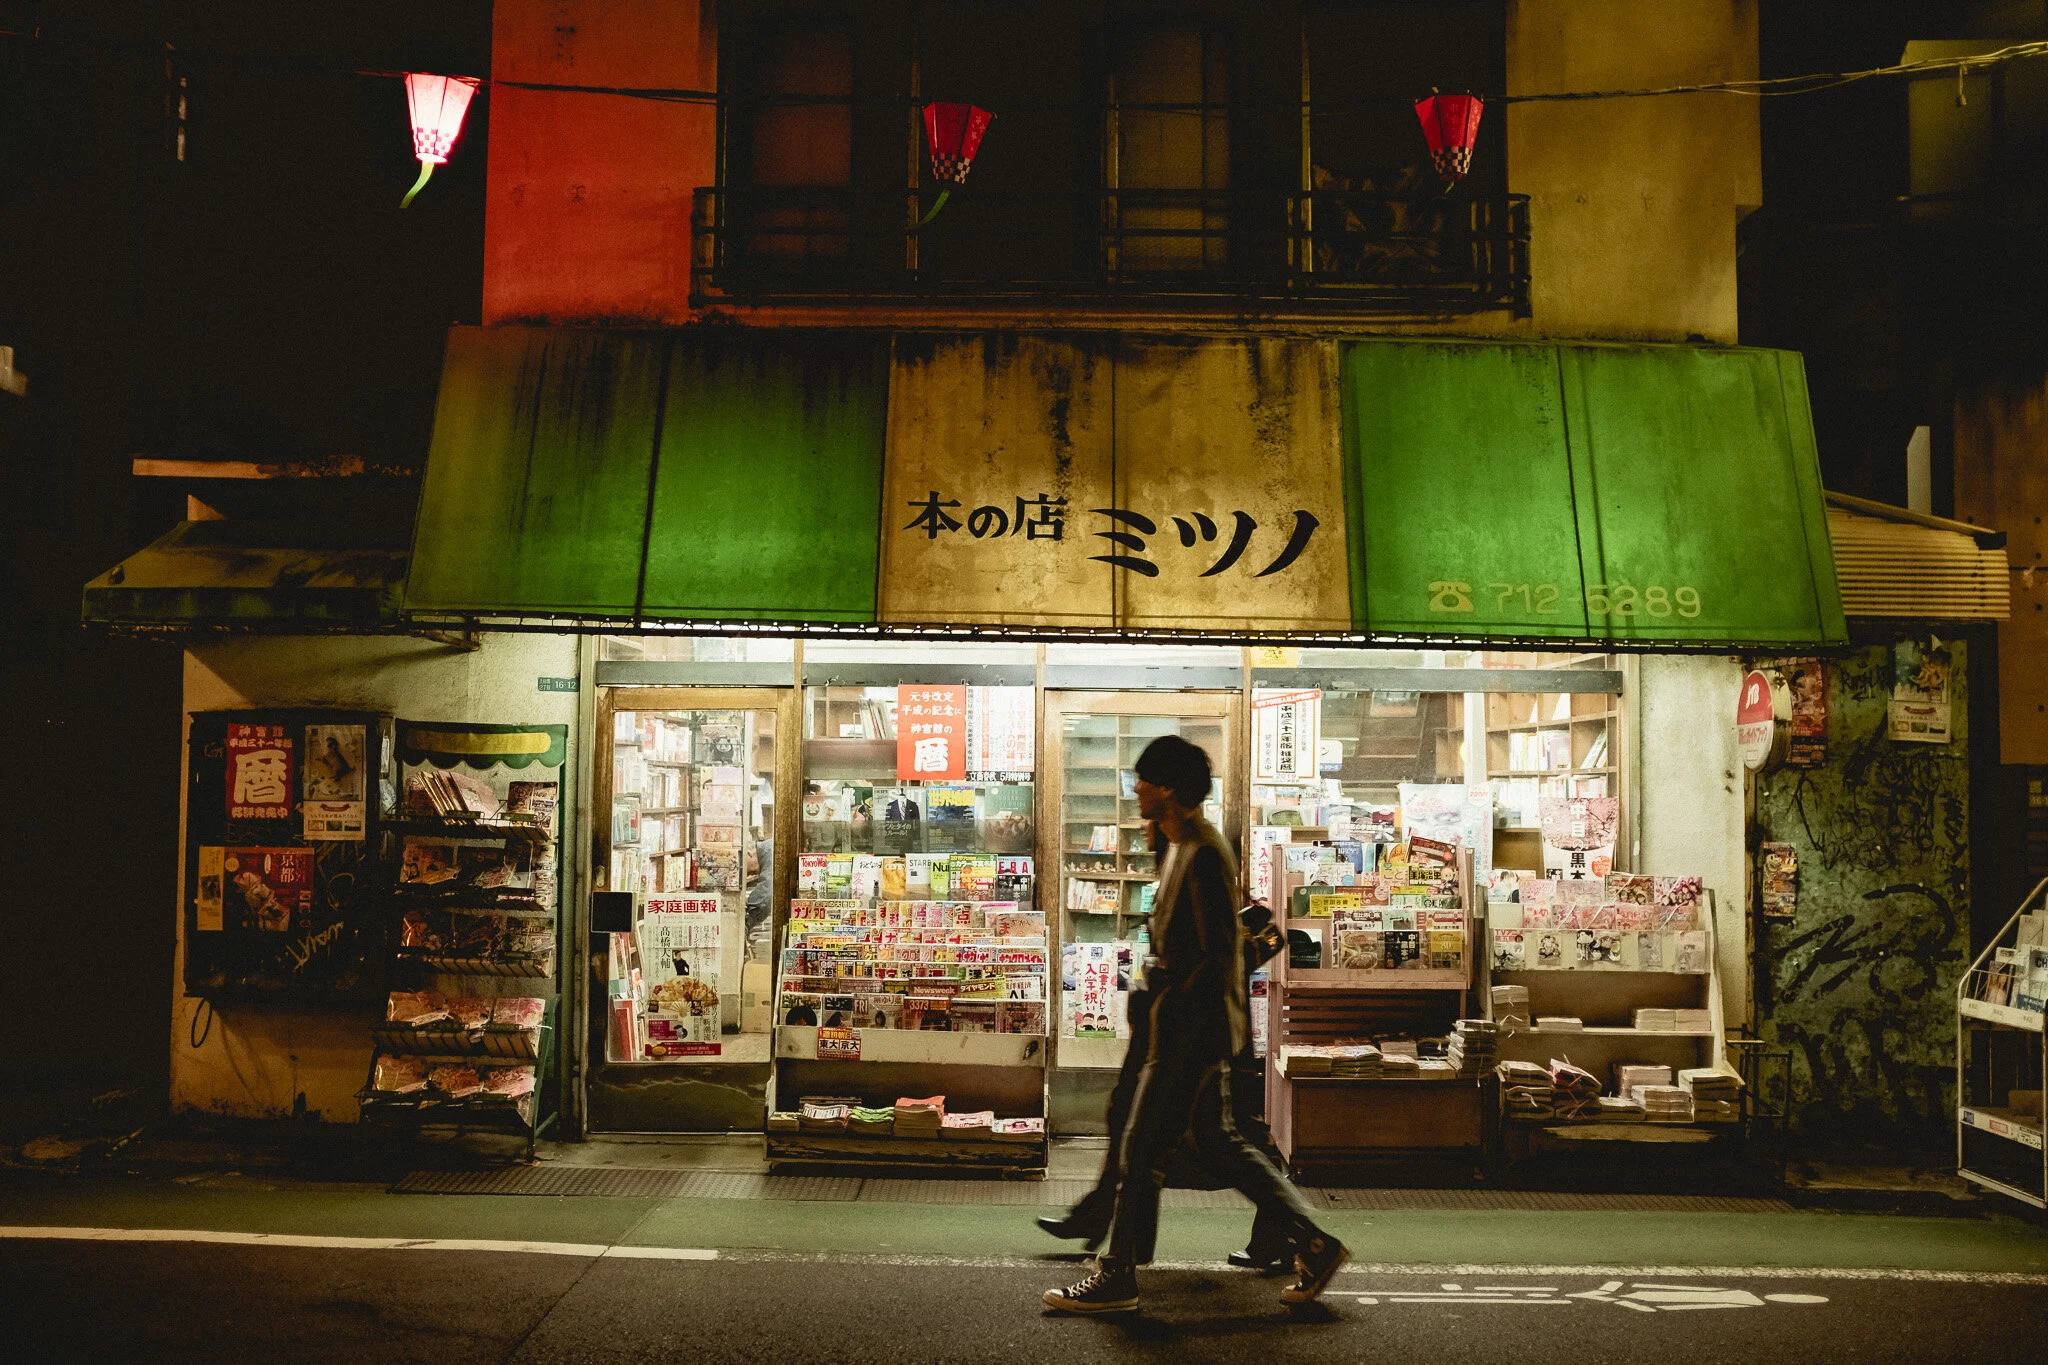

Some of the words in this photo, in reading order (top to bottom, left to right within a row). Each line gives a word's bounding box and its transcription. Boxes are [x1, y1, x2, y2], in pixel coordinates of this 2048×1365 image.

[903, 491, 1067, 541] 本の店
[1087, 508, 1320, 578] ミツノ
[909, 691, 955, 702] 元号改定
[1745, 683, 1760, 709] JTB
[901, 704, 962, 716] 平成の記念に
[239, 725, 284, 737] 神宮館
[910, 723, 953, 734] 神宮館の
[229, 738, 292, 748] 平成三十一年版
[914, 737, 949, 773] 暦
[234, 749, 287, 804] 暦
[1570, 803, 1587, 879] 中目の黒本
[647, 899, 717, 914] 家庭画報
[913, 985, 956, 994] Newsweek
[1084, 963, 1098, 1011] 入学祝い
[1099, 963, 1110, 1012] 図書カードで
[909, 1000, 929, 1010] 3373
[820, 1040, 839, 1050] 東大
[841, 1040, 860, 1050] 京大
